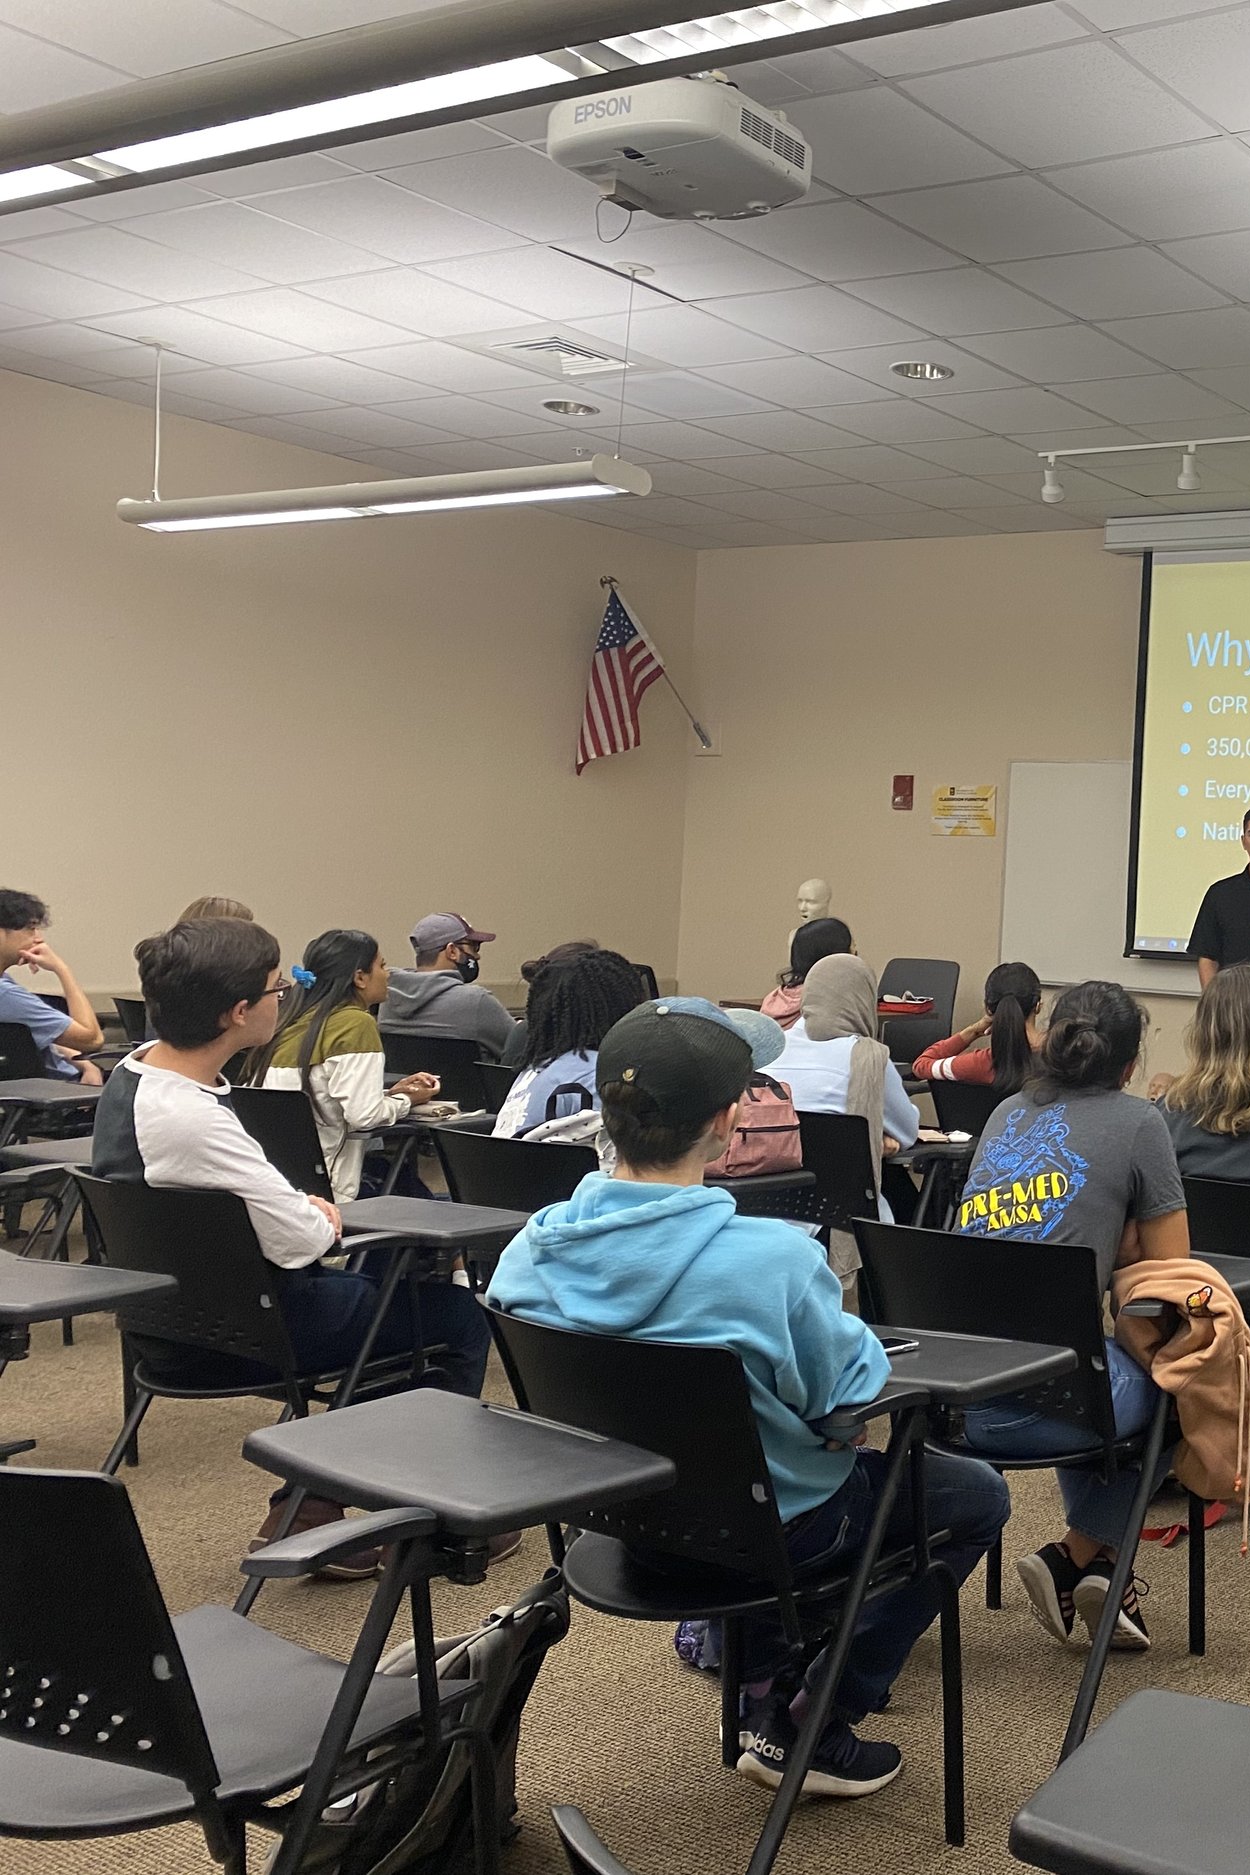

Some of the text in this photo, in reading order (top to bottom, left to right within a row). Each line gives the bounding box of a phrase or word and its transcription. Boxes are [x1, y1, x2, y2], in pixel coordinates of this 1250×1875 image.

[574, 95, 632, 124] EPSON
[1208, 695, 1248, 714] CPR
[1202, 822, 1243, 841] Nati
[960, 1172, 1069, 1228] PRE-MED
[987, 1203, 1043, 1232] AMSA
